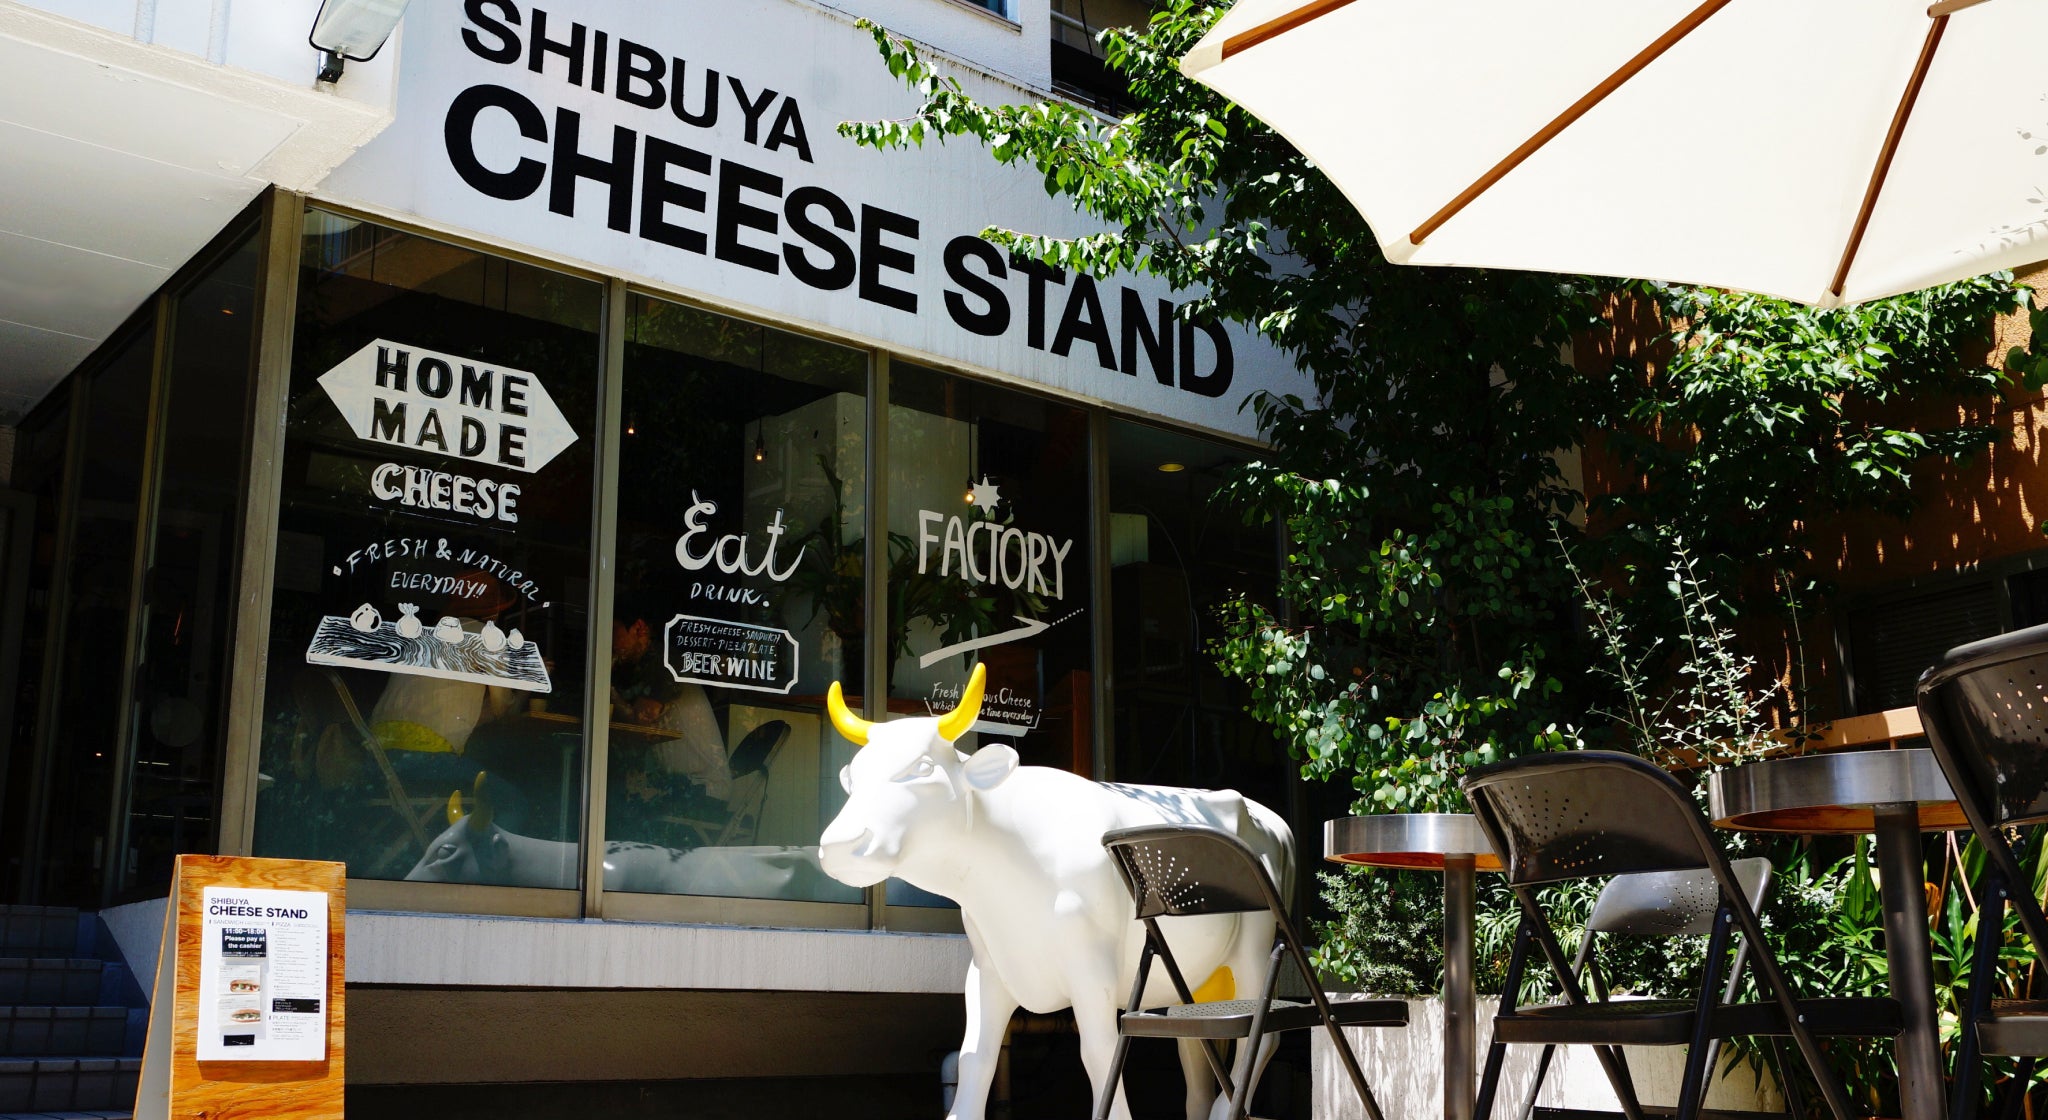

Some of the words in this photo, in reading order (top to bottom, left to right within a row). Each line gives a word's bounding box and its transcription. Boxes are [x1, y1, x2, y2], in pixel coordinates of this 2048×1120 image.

[462, 0, 813, 163] SHIBUYA
[444, 83, 920, 315] CHEESE
[942, 235, 1235, 399] STAND
[375, 345, 529, 417] HOME
[371, 398, 527, 469] MADE
[371, 462, 521, 523] CHEESE
[675, 488, 806, 582] Eat
[918, 509, 1073, 600] FACTORY
[346, 538, 428, 575] FRESH
[435, 538, 452, 561] &
[456, 547, 541, 601] NATURAL
[390, 571, 488, 600] EVERYDAY!!
[931, 681, 960, 700] Fresh
[999, 687, 1032, 708] Cheese
[210, 897, 249, 906] SHIBUYA
[210, 906, 262, 916] CHEESE
[266, 908, 308, 919] STAND
